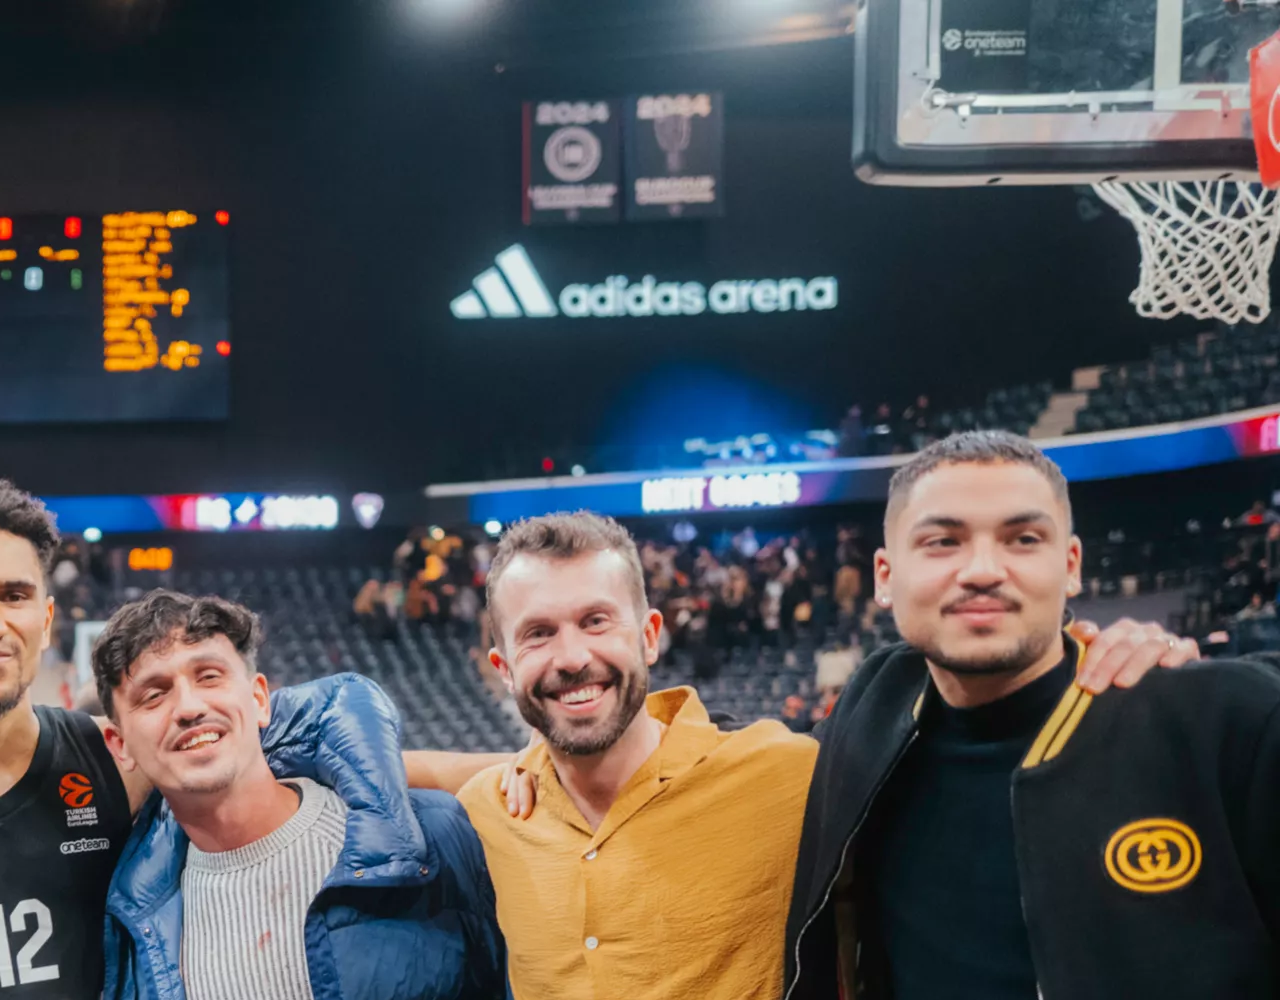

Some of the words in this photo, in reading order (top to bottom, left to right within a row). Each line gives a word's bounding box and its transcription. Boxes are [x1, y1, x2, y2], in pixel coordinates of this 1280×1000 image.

[558, 274, 707, 318] adidas
[708, 276, 838, 314] arena
[65, 806, 97, 816] TURKISH
[66, 812, 98, 822] AIRLINES
[60, 838, 110, 855] oneteam
